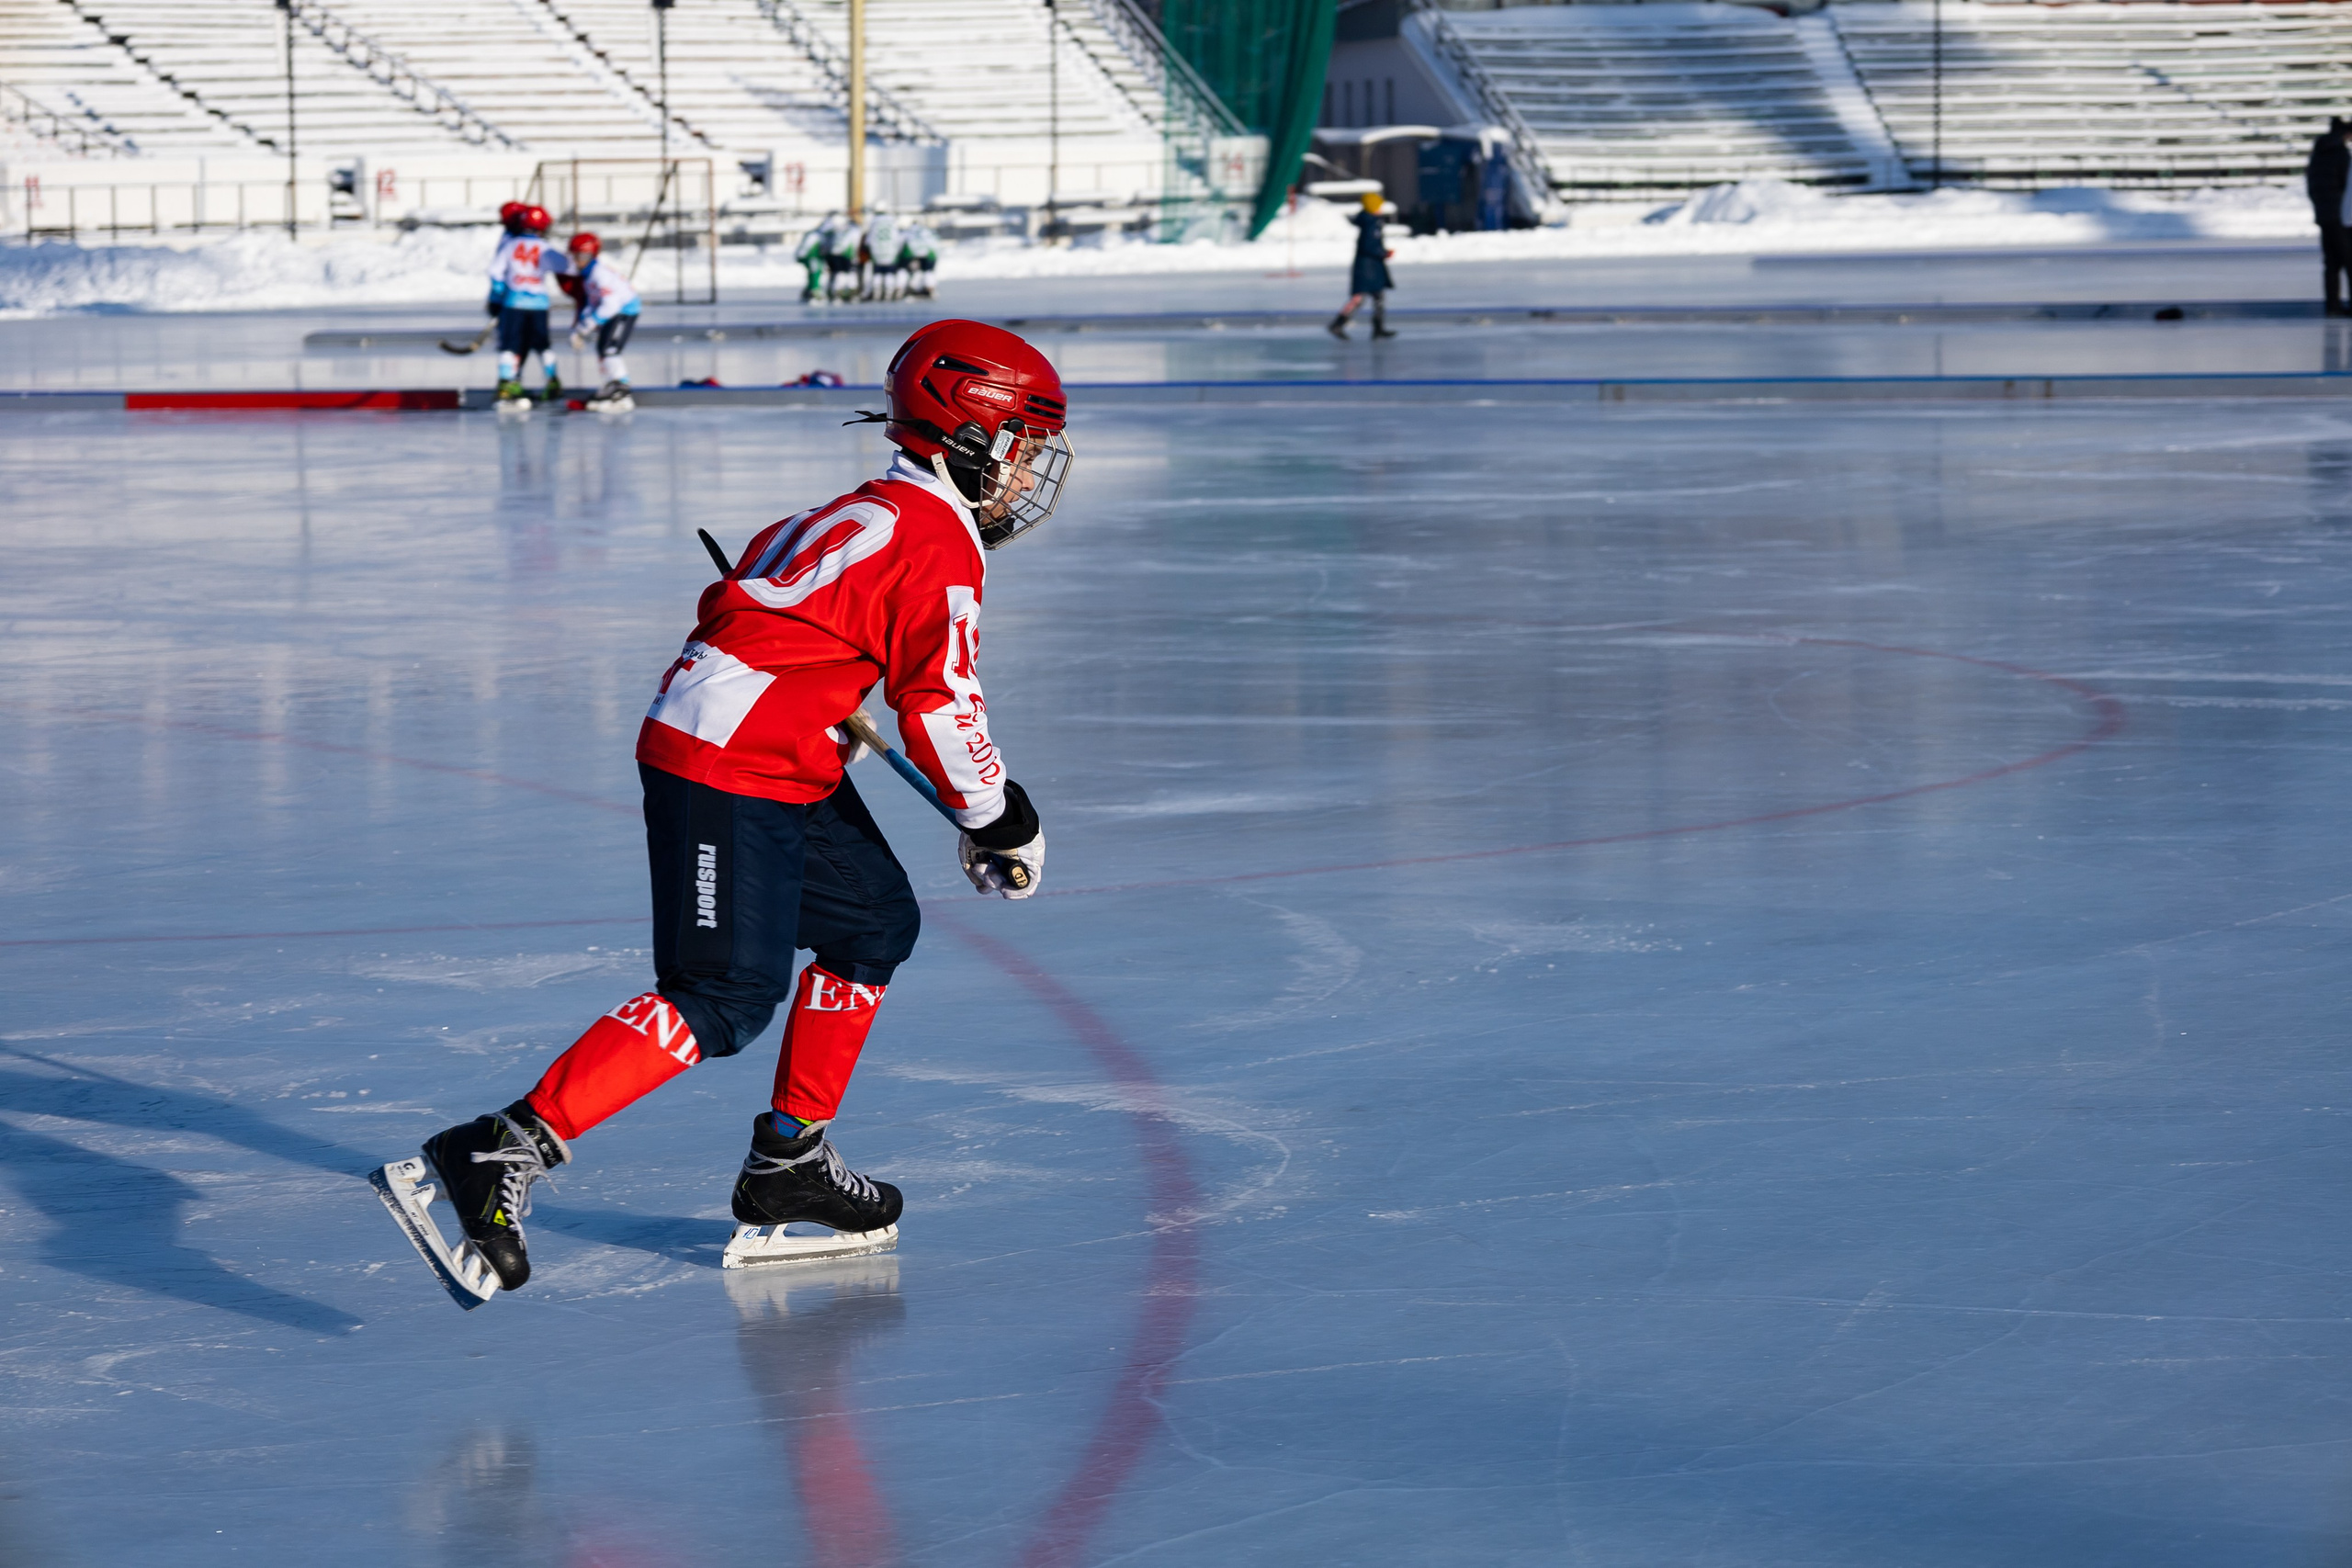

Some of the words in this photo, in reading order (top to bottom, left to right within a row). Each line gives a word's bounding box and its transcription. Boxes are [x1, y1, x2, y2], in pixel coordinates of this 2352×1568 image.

[967, 387, 1013, 403] BAUER
[966, 731, 1001, 785] 2012
[695, 843, 718, 929] rusport
[803, 973, 888, 1011] EN
